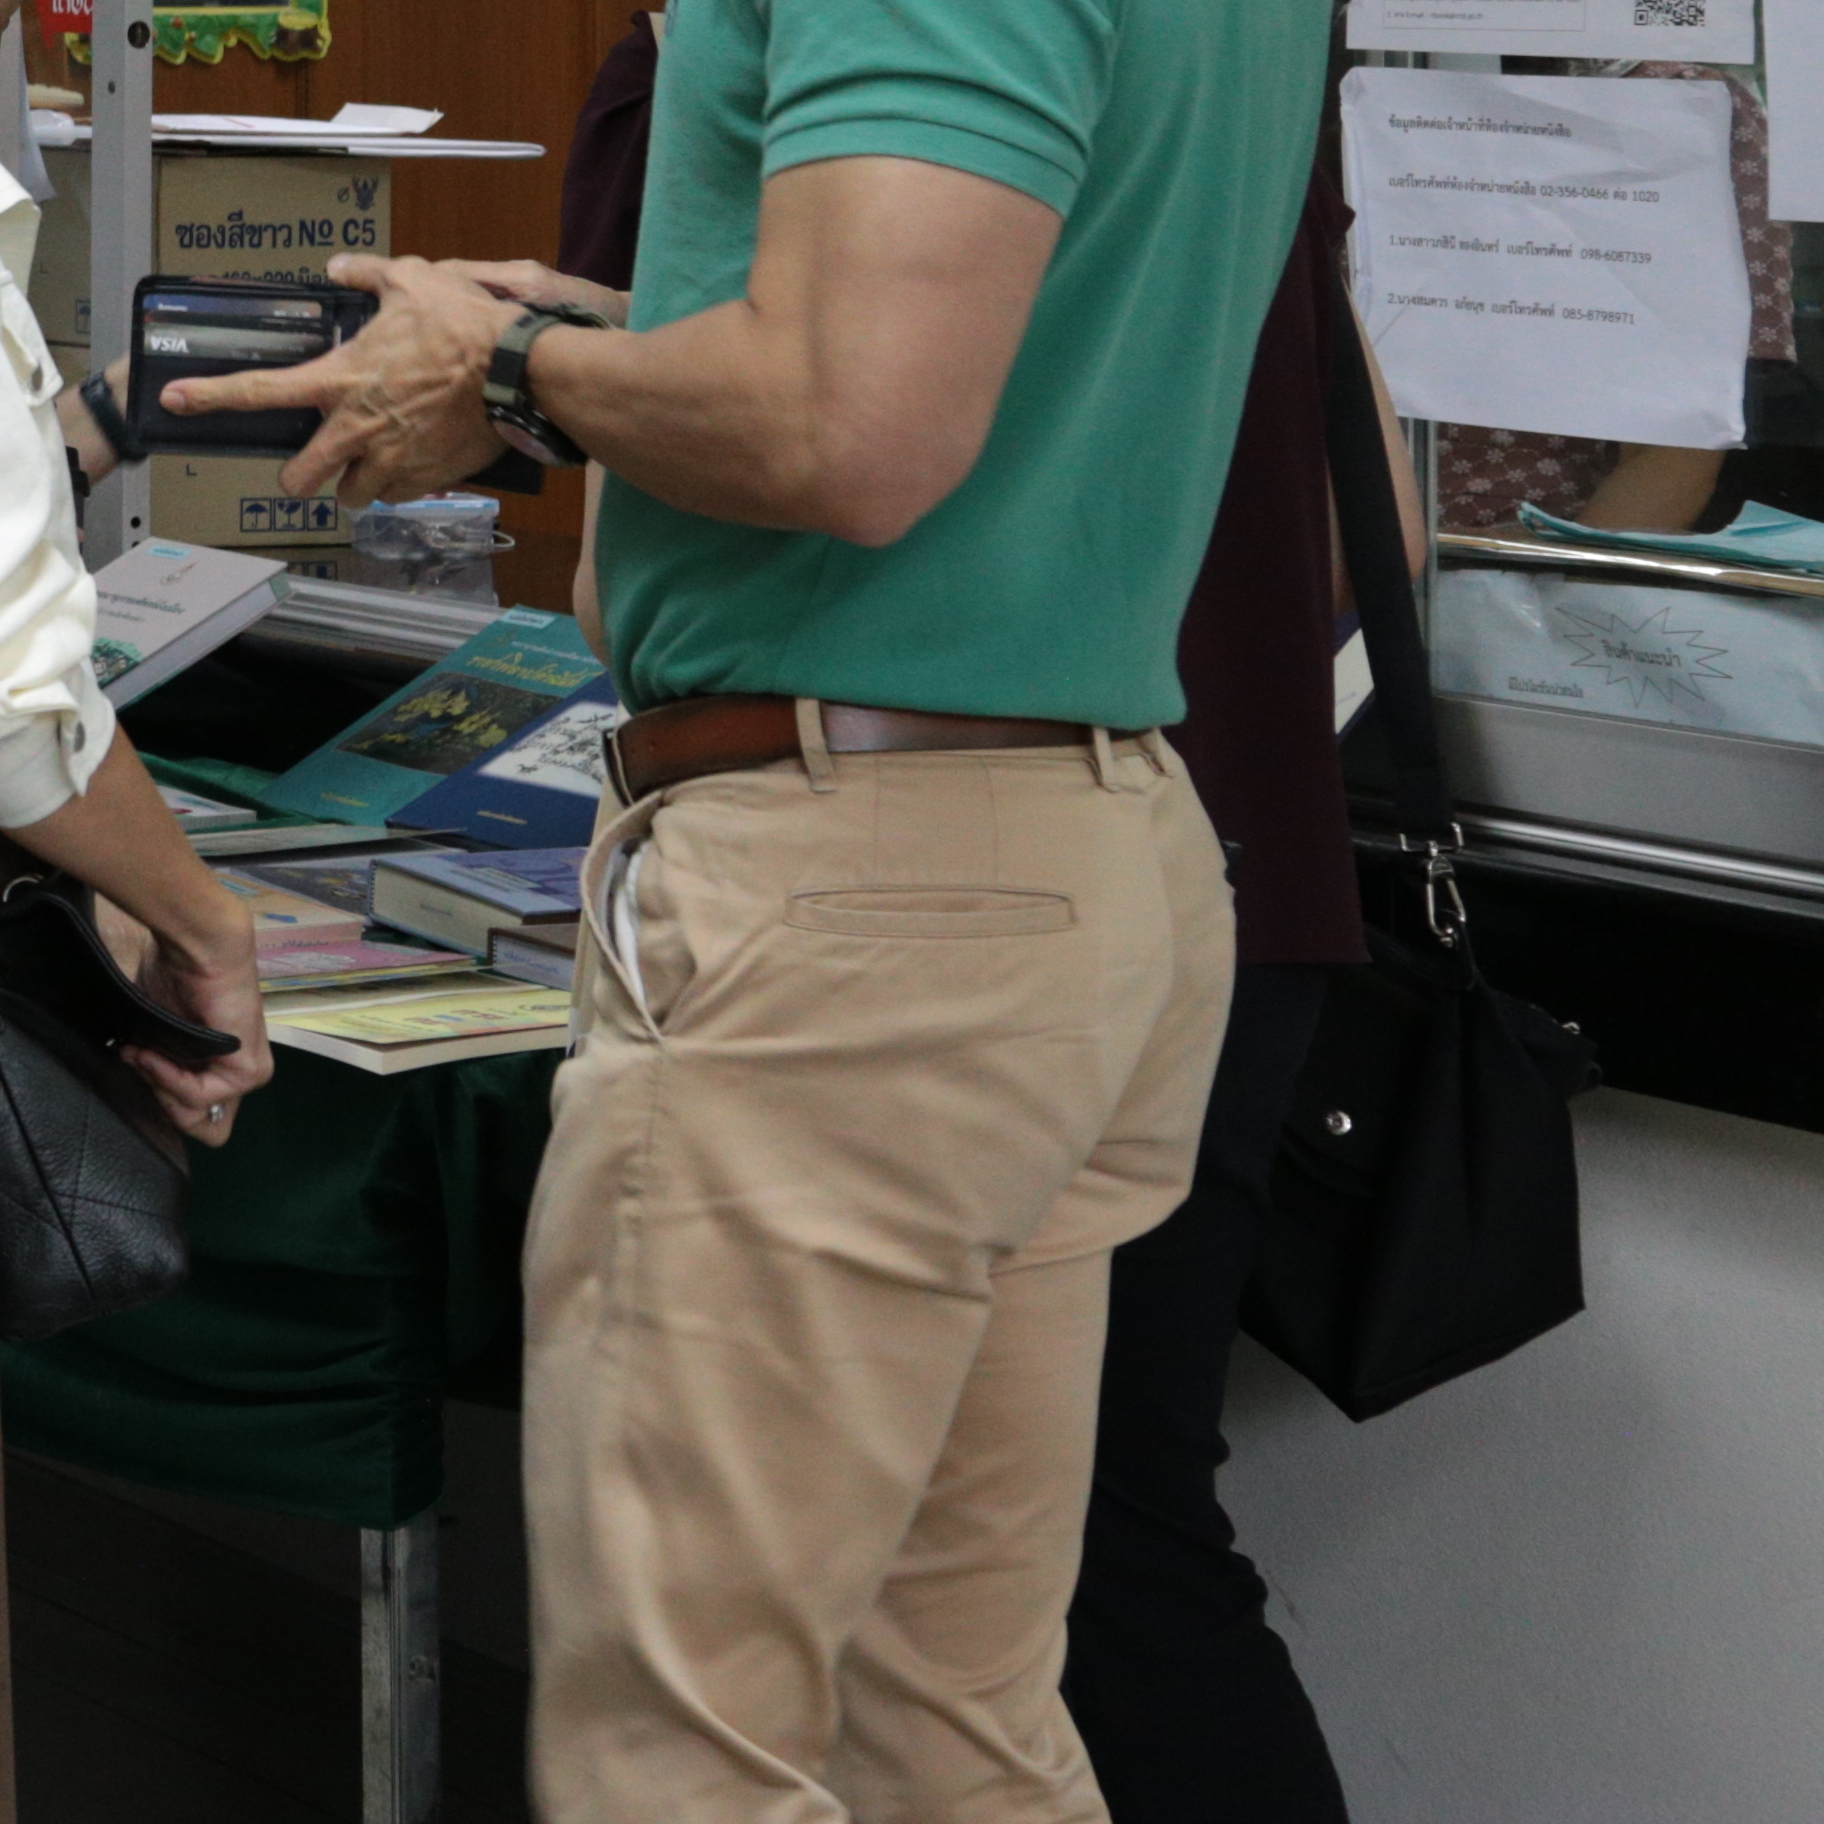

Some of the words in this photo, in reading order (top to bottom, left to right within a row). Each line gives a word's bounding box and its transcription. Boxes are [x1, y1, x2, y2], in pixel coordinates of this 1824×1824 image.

[1540, 186, 1609, 200] 02-356-0466
[1632, 190, 1660, 203] 1020
[175, 210, 293, 249] ซองสีขาว
[342, 218, 376, 247] C5
[150, 334, 189, 354] VISA
